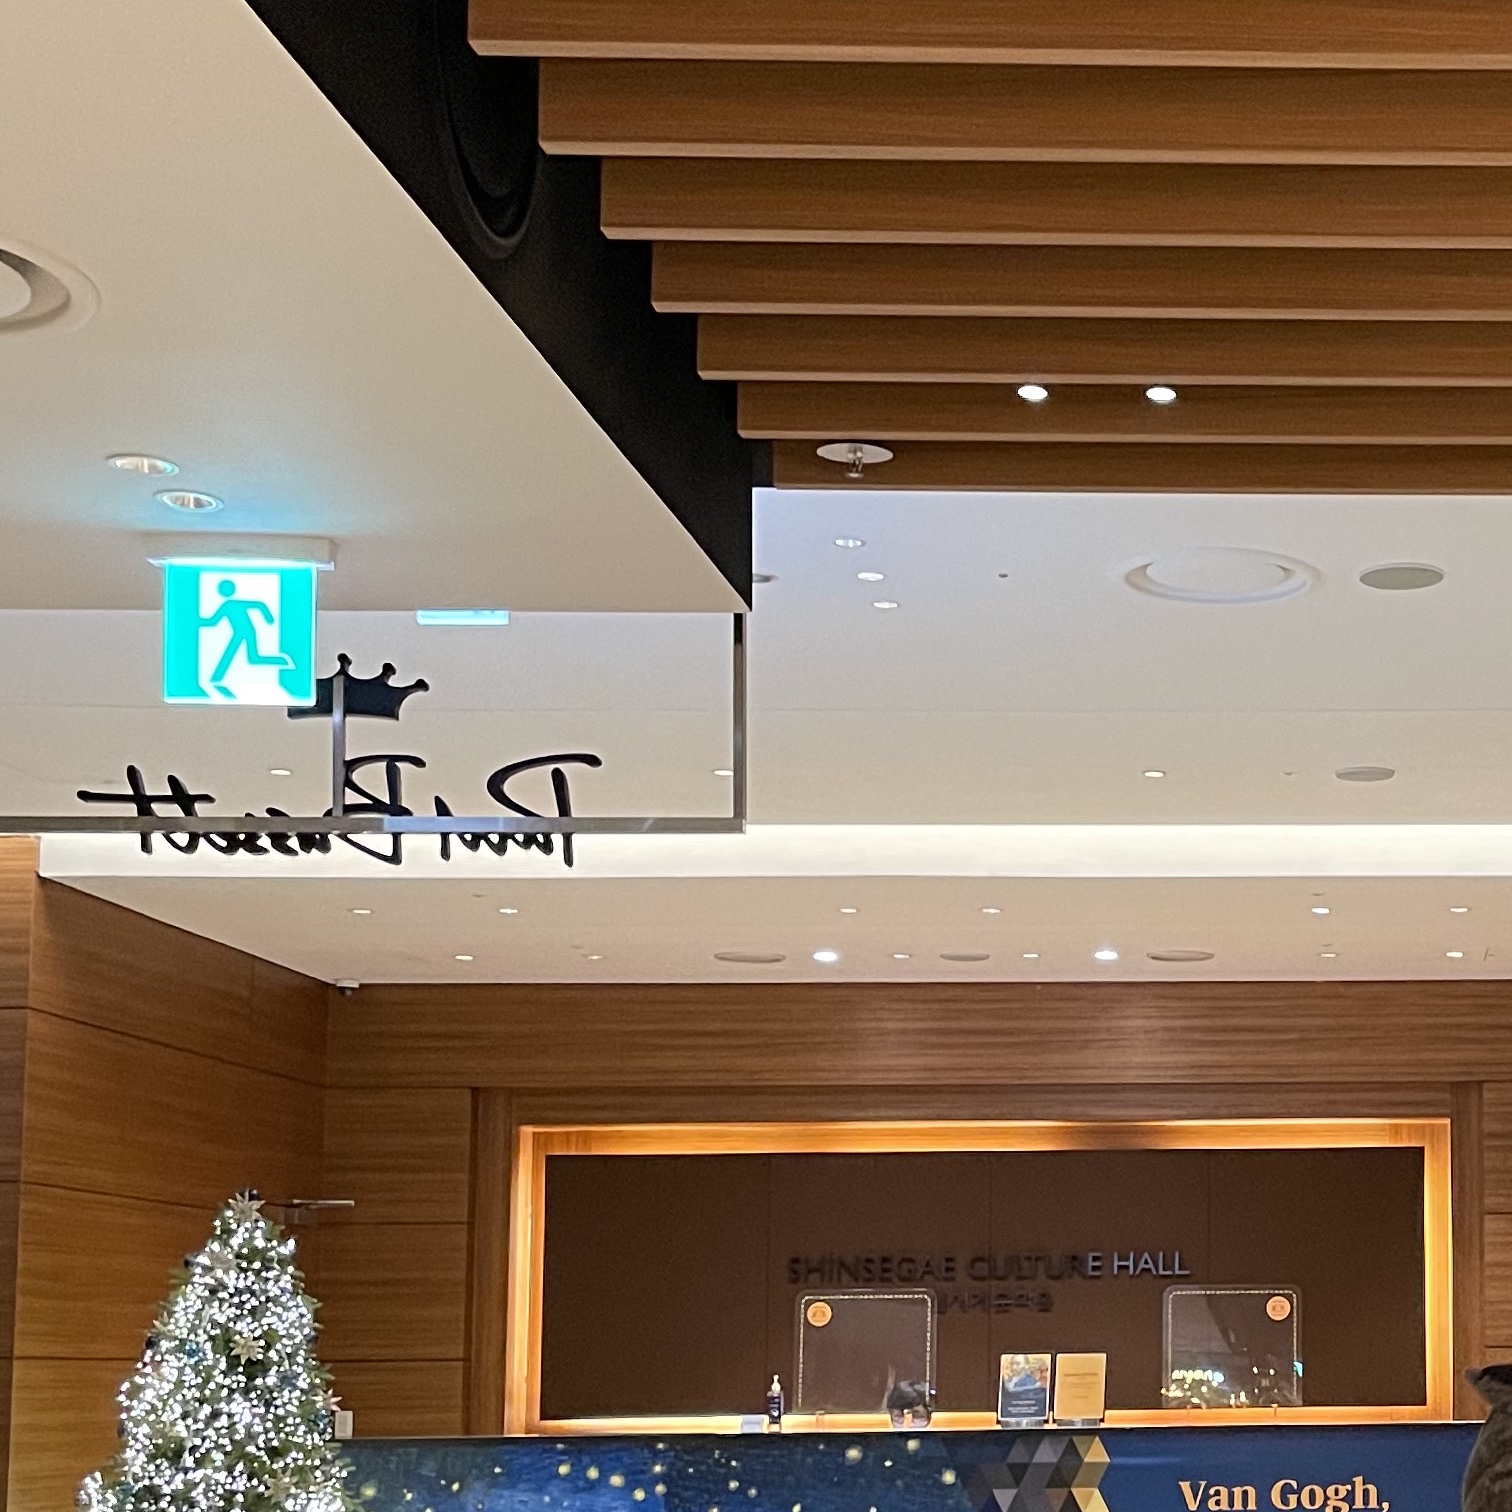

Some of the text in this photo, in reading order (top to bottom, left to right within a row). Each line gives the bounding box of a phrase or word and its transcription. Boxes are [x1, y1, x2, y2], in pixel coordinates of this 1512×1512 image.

[788, 1251, 1190, 1284] SHINSEGAE CULTURE HALL
[1178, 1480, 1257, 1512] Van
